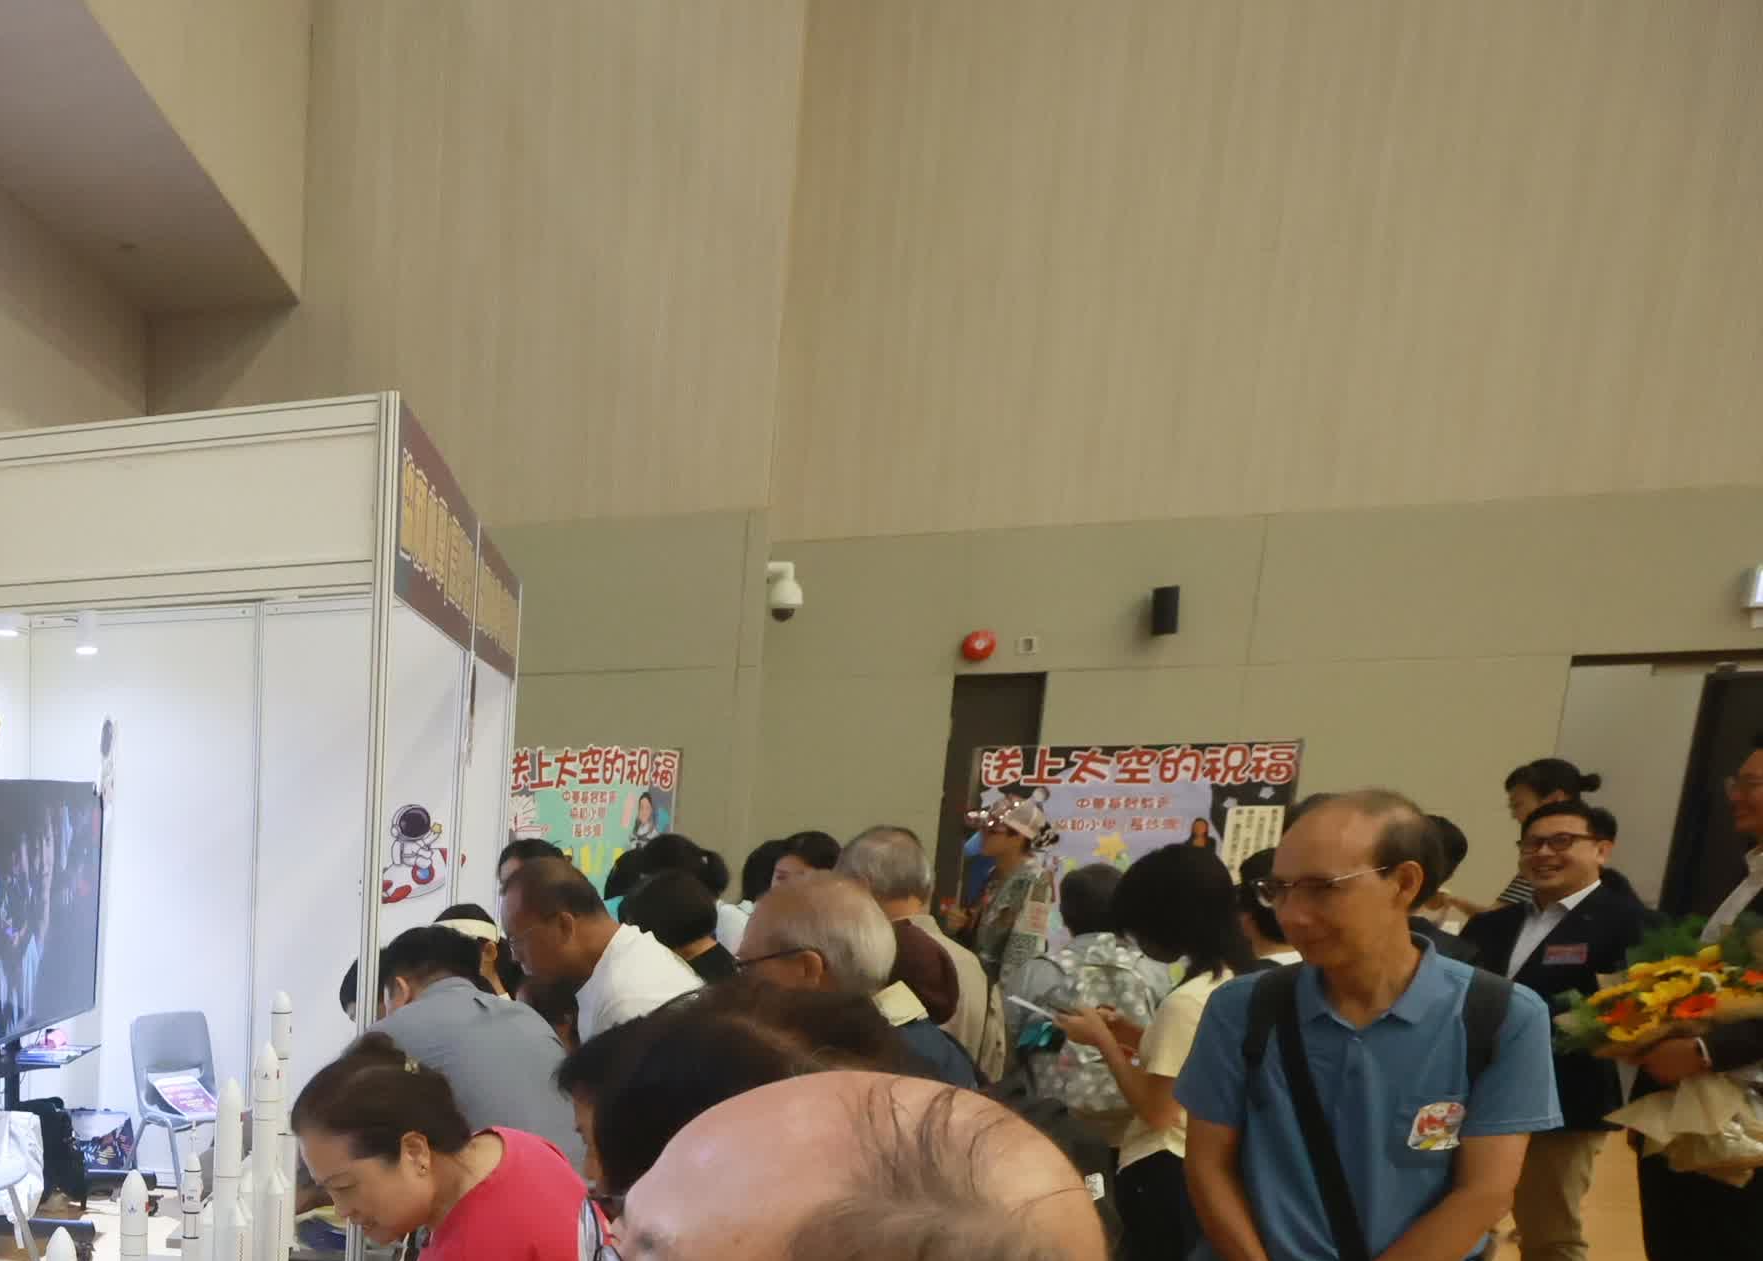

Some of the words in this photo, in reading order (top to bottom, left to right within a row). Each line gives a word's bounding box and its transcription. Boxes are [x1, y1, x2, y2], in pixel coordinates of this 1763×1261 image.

[981, 744, 1298, 787] 送上太空的祝福
